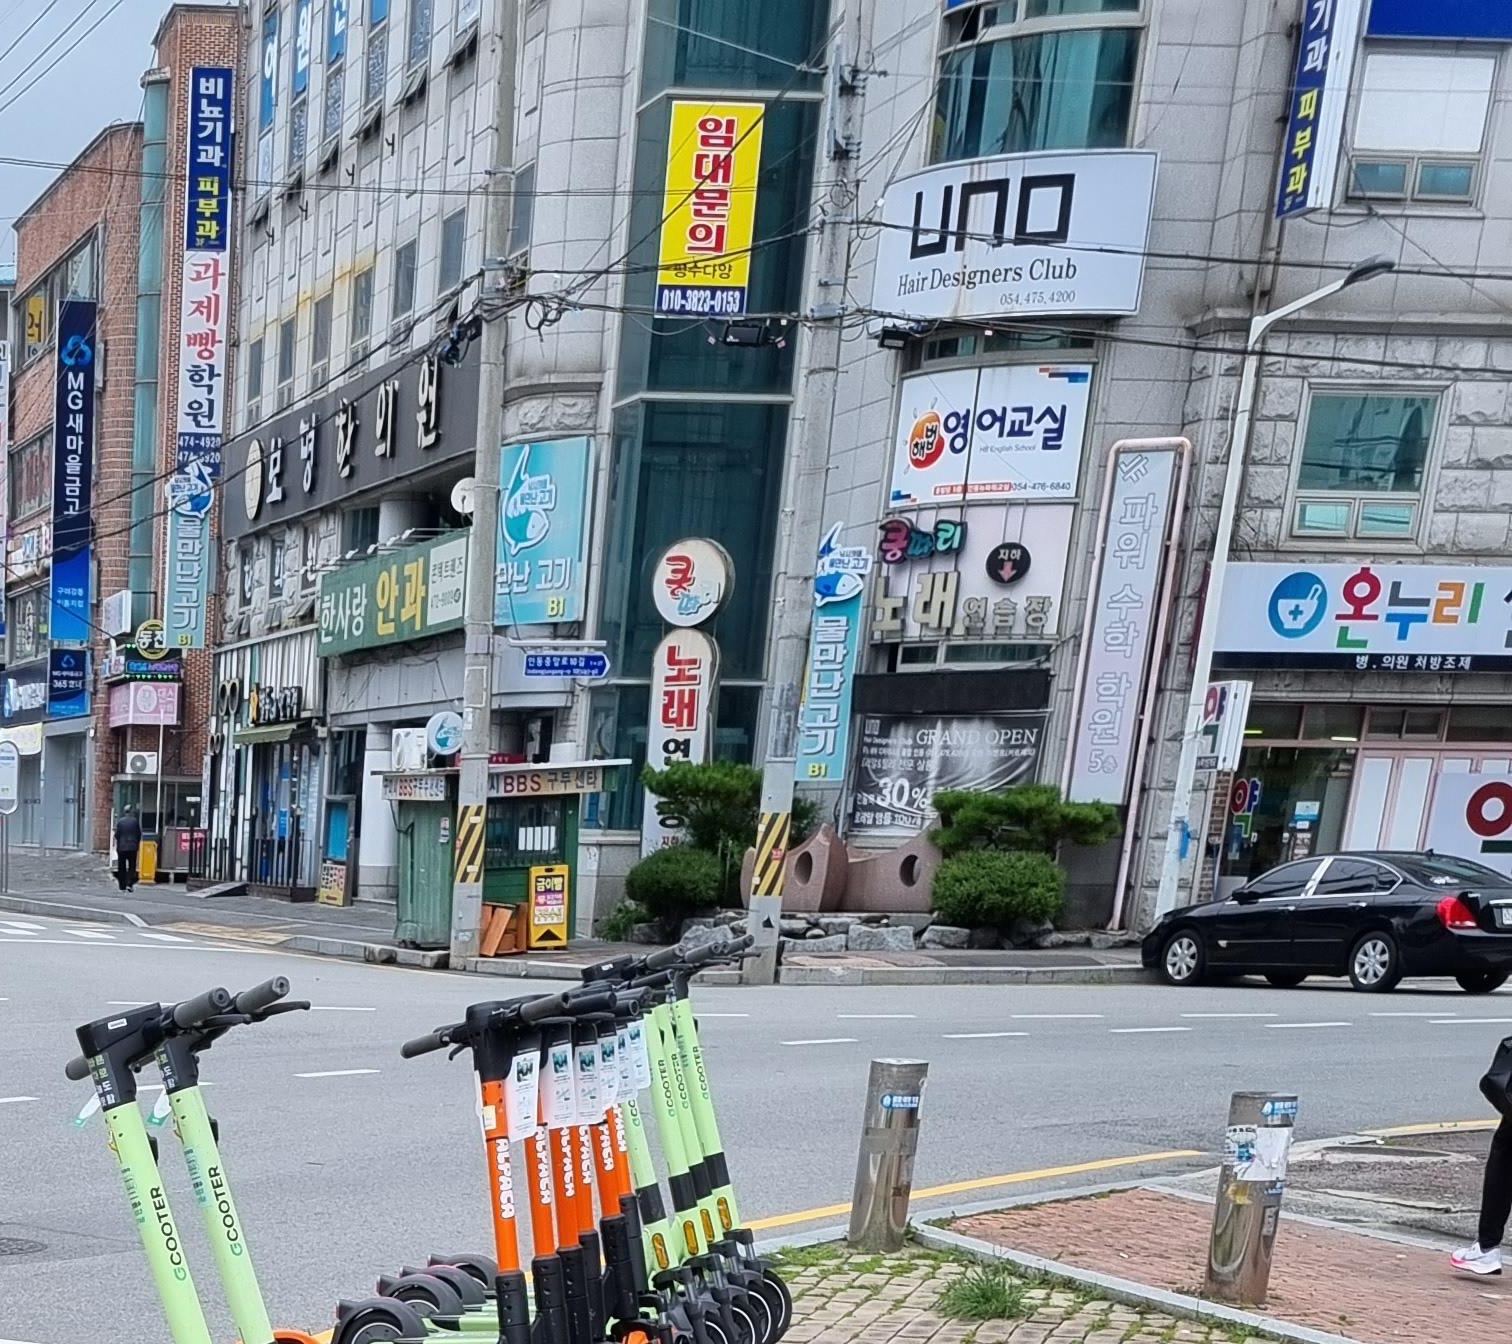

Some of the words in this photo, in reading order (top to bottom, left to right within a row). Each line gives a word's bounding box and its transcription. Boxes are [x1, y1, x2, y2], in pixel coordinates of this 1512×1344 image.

[196, 77, 225, 167] 비뇨기과
[1286, 88, 1319, 199] 피부과
[195, 175, 221, 240] 피부과
[687, 117, 736, 255] 임대문의
[661, 288, 740, 313] 010-3823-0153
[673, 261, 732, 280] 평수다양
[897, 271, 929, 297] Hair
[929, 264, 1023, 291] Designers
[1028, 256, 1078, 281] Club
[63, 371, 85, 515] MG새마을금고
[178, 435, 221, 449] 474-4920
[265, 353, 443, 504] 보명한의원
[911, 421, 940, 461] 해법
[943, 403, 1067, 455] 영어교실
[997, 549, 1021, 561] 지하
[1112, 492, 1158, 570] 파워
[320, 582, 367, 644] 한사랑
[376, 555, 427, 637] 안과
[535, 556, 574, 591] 고기
[962, 595, 1053, 629] 연습장
[1103, 583, 1143, 659] 수학
[1334, 566, 1486, 649] 온누리
[661, 644, 702, 731] 노래
[802, 616, 849, 756] 물만난고기
[1414, 655, 1472, 670] 처방조제
[916, 728, 981, 746] GRAND
[985, 727, 1039, 745] OPEN
[1087, 671, 1132, 746] 학원
[397, 777, 413, 797] BBS
[503, 774, 542, 794] BBS
[547, 766, 599, 790] 구두센타
[808, 762, 828, 777] B1
[878, 776, 928, 809] 30%
[1230, 776, 1262, 838] 약
[535, 877, 564, 892] 금이빨
[494, 1138, 517, 1219] ALPACA
[150, 1186, 188, 1283] GCOOTER
[208, 1165, 244, 1258] GCOOTER
